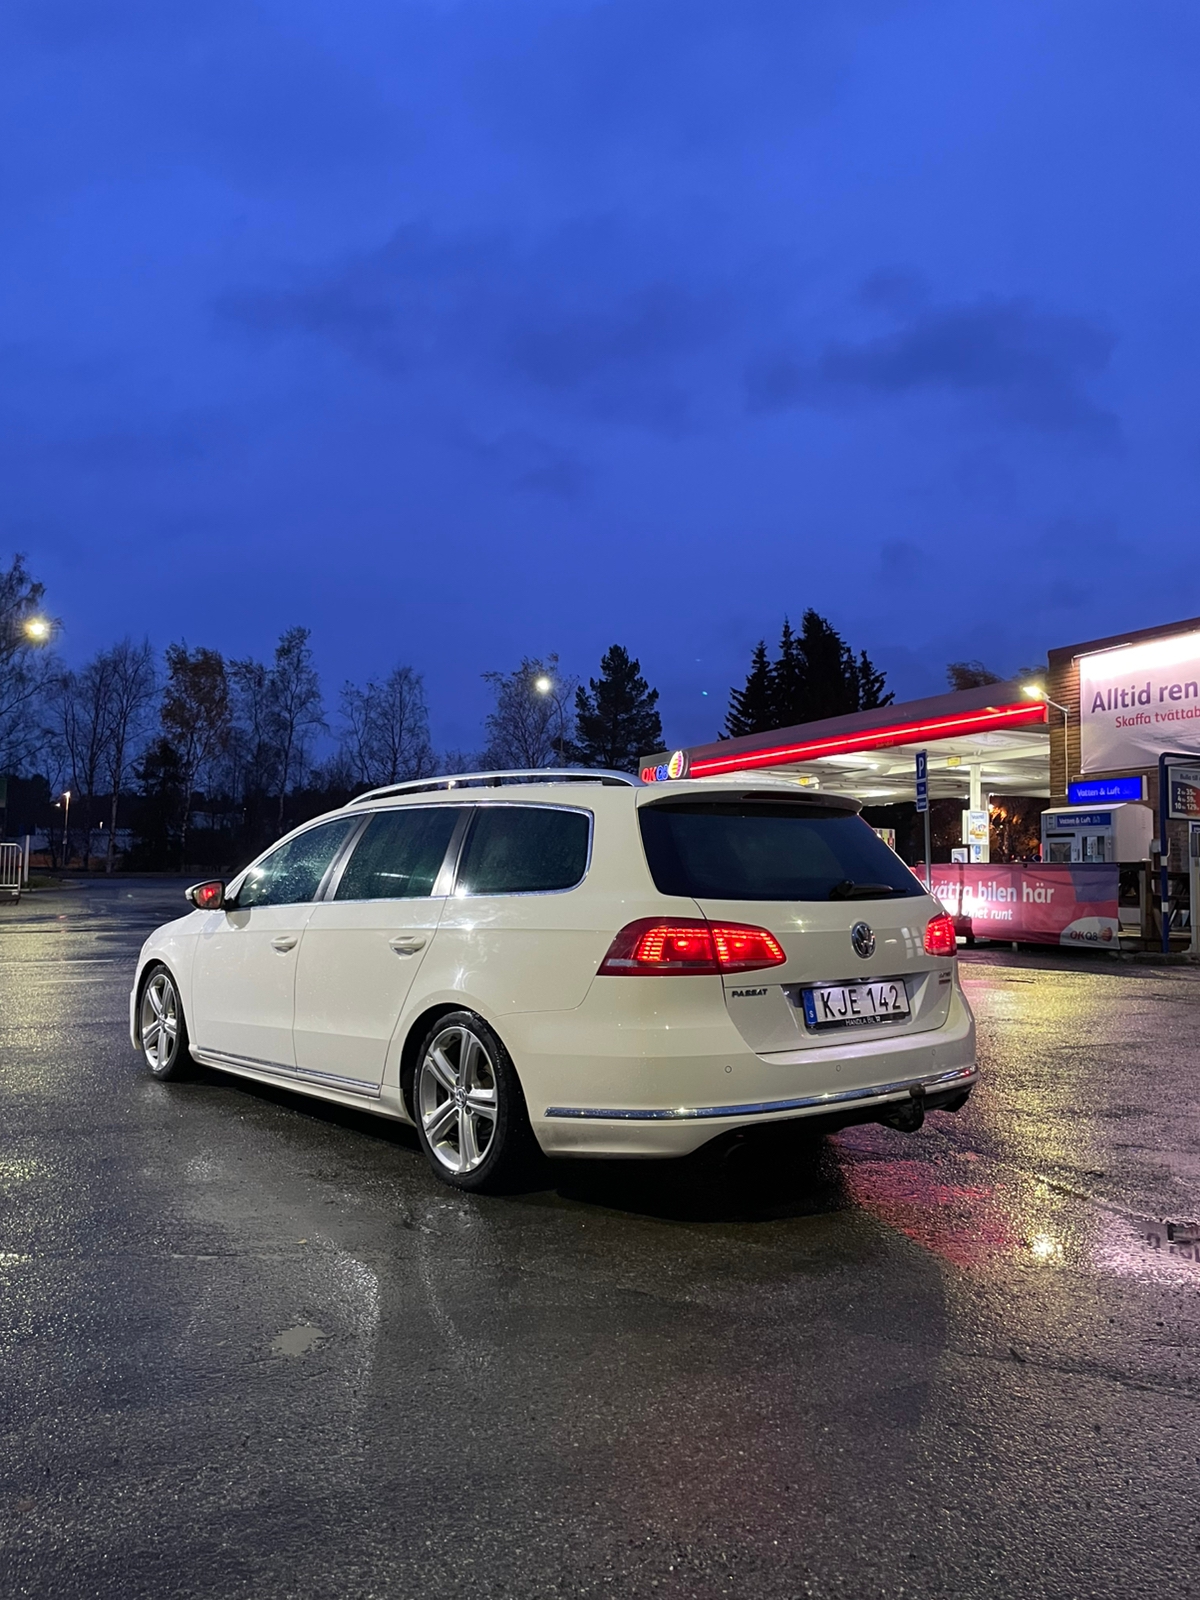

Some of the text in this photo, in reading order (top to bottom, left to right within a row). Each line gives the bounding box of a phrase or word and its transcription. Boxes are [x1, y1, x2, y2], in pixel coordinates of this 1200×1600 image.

[1091, 680, 1198, 714] Alltid ren
[1115, 712, 1151, 728] Skaffa
[919, 757, 925, 777] P
[1076, 786, 1121, 797] Vatten & Luft
[978, 881, 1017, 902] bilen
[1022, 881, 1055, 904] här
[990, 908, 1013, 920] runt
[1069, 930, 1098, 941] OKQ8
[731, 988, 768, 998] PASSAT
[820, 984, 901, 1018] KJE 142
[808, 1010, 815, 1018] S
